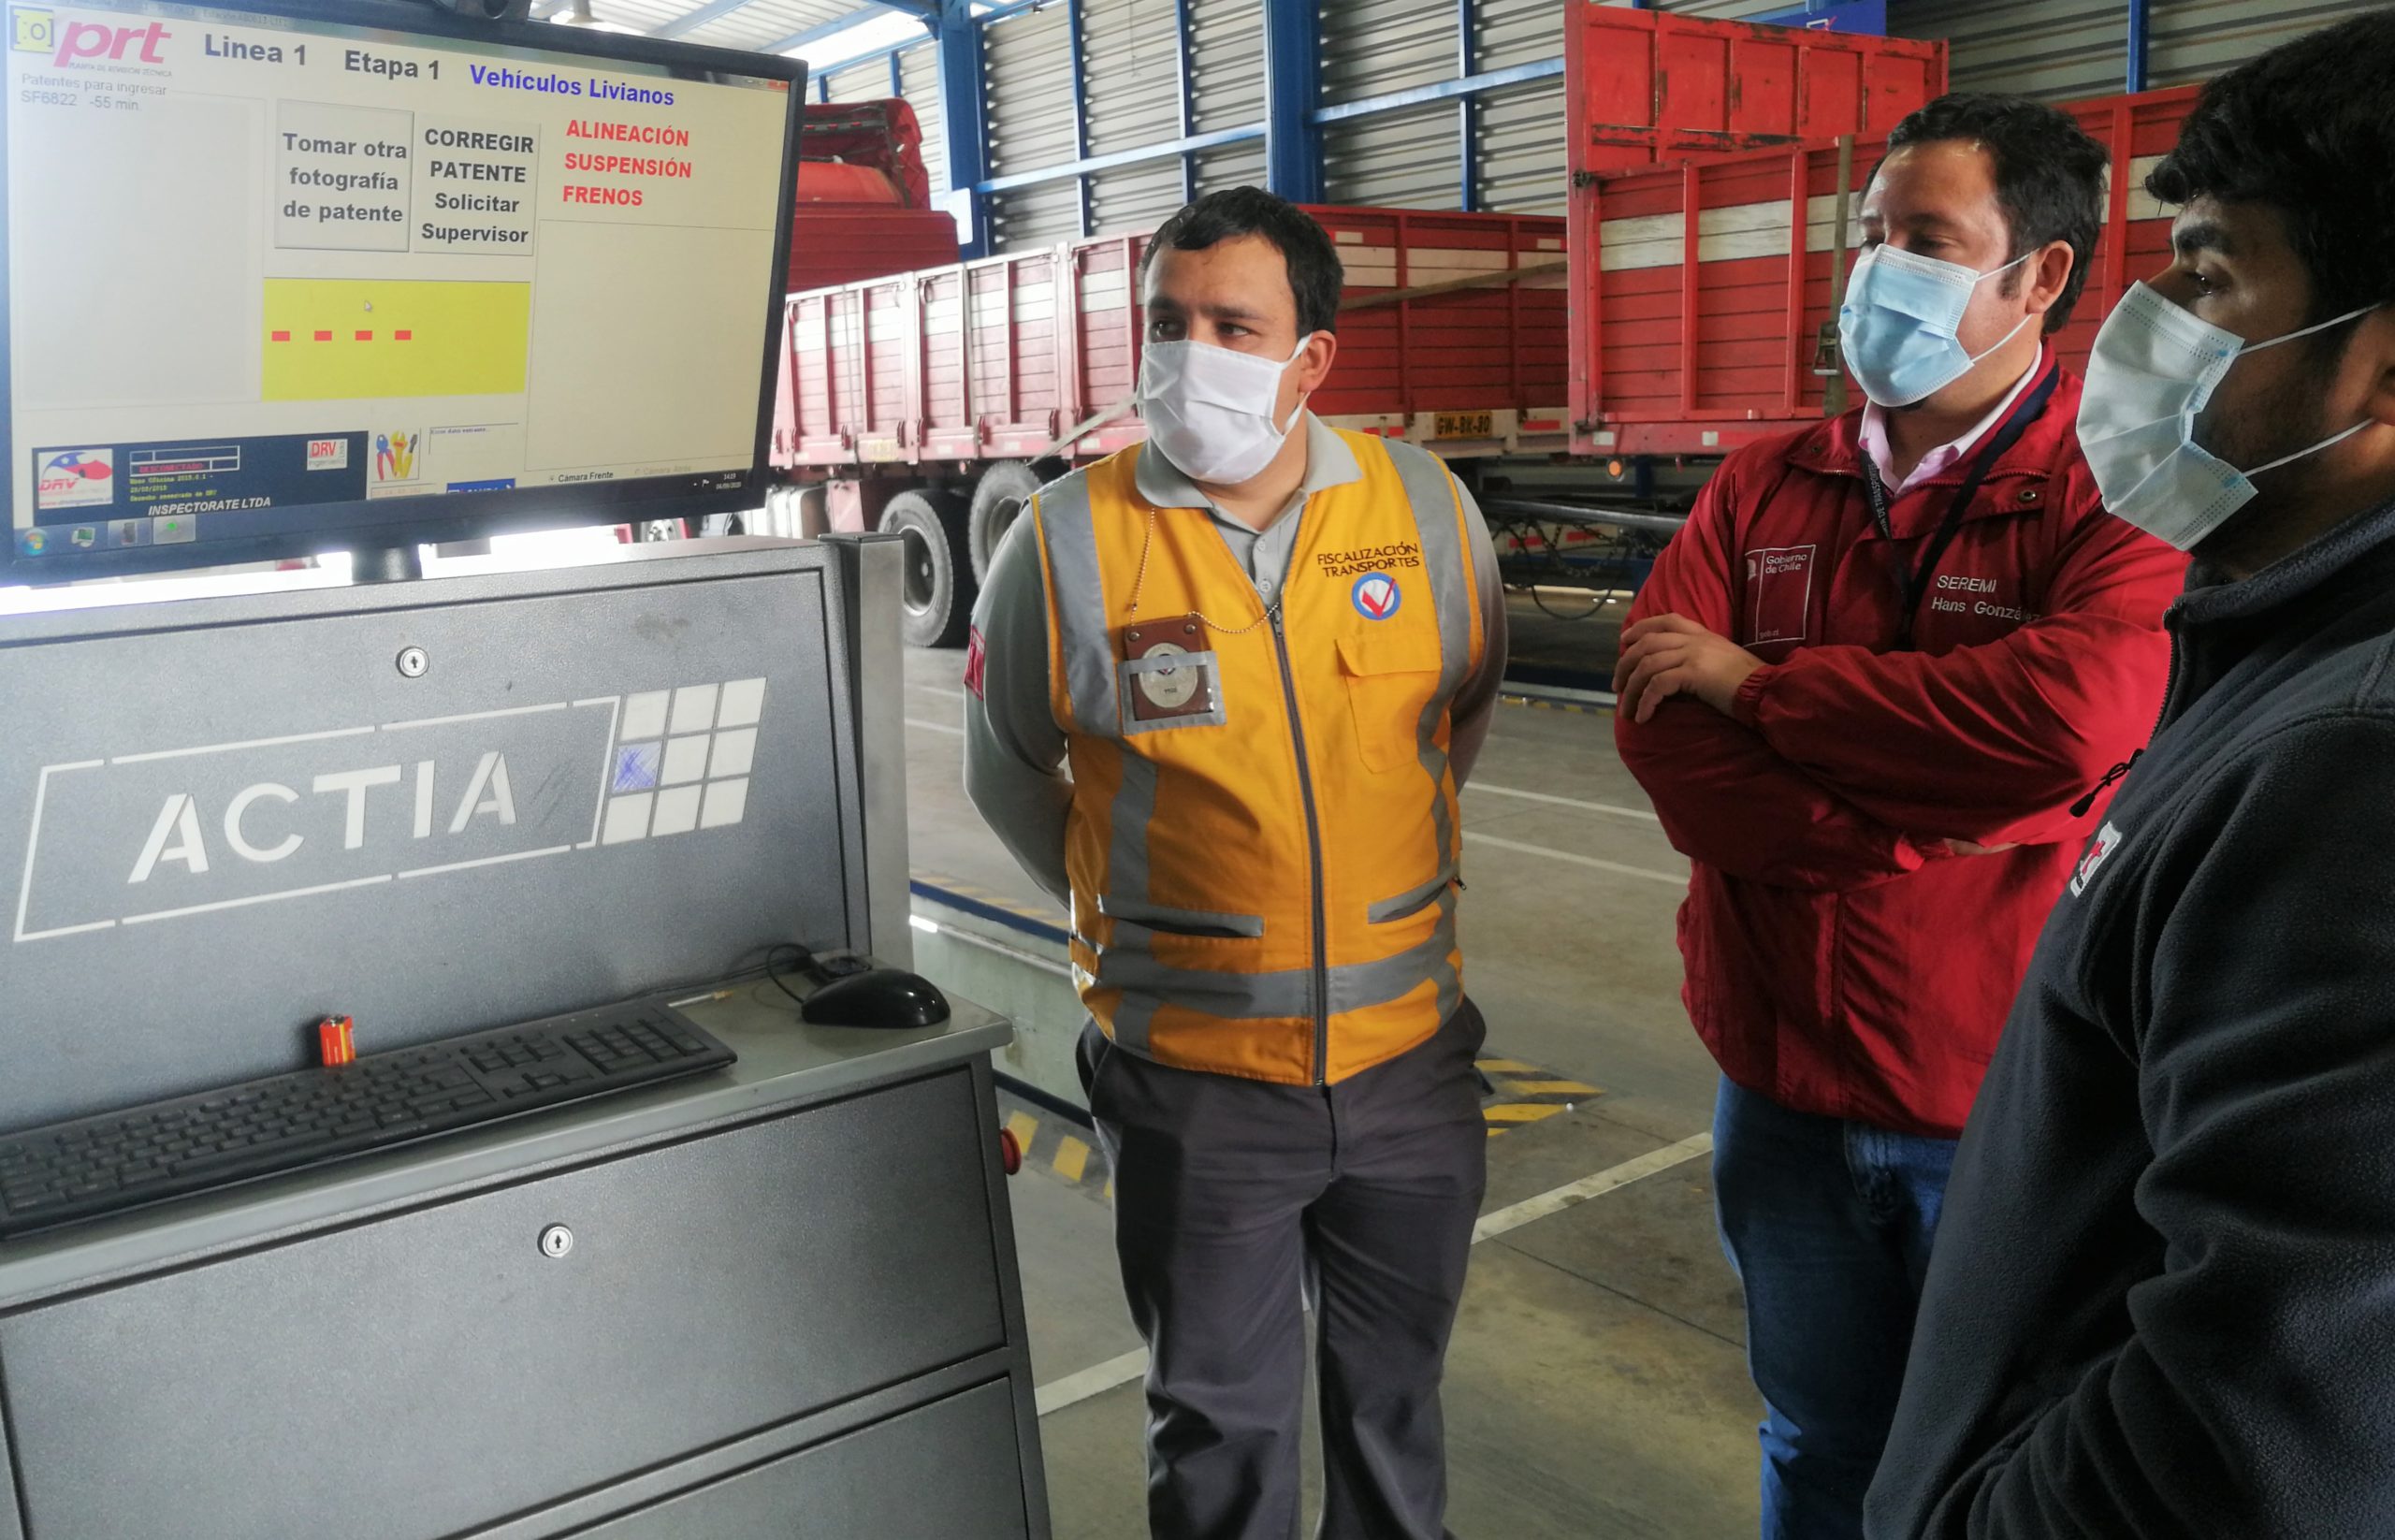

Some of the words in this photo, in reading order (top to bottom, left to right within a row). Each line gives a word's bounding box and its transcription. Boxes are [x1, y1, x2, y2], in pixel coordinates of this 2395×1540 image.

[53, 22, 172, 68] prt
[204, 34, 283, 64] Linea
[294, 45, 307, 65] 1
[344, 50, 419, 80] Etapa
[428, 60, 441, 80] 1
[22, 73, 81, 89] Patentes
[84, 80, 113, 92] para
[117, 82, 167, 96] ingresar
[470, 64, 582, 95] Vehículos
[588, 79, 675, 106] Livianos
[21, 90, 78, 107] SF6822
[425, 128, 534, 153] CORREGIR
[565, 119, 689, 147] ALINEACIÓN
[283, 132, 357, 155] Tomar
[363, 138, 408, 159] otra
[430, 160, 527, 183] PATENTE
[564, 153, 692, 179] SUSPENSIÓN
[289, 167, 399, 192] fotografía
[434, 192, 520, 213] Solicitar
[562, 185, 644, 207] FRENOS
[283, 199, 312, 219] de
[319, 204, 404, 223] patente
[421, 223, 530, 244] Supervisor
[588, 470, 614, 482] Frente
[148, 498, 240, 516] INSPECTORATE
[240, 496, 271, 511] LTDA
[1317, 541, 1418, 565] FISCALIZACIÓN
[1765, 553, 1808, 565] Gobierno
[1322, 556, 1420, 577] TRANSPORTES
[1765, 565, 1778, 574] de
[1778, 563, 1802, 574] Chile
[1937, 574, 1997, 594] SEREMI
[1930, 596, 1967, 613] Hans
[126, 750, 517, 884] ACTIA
